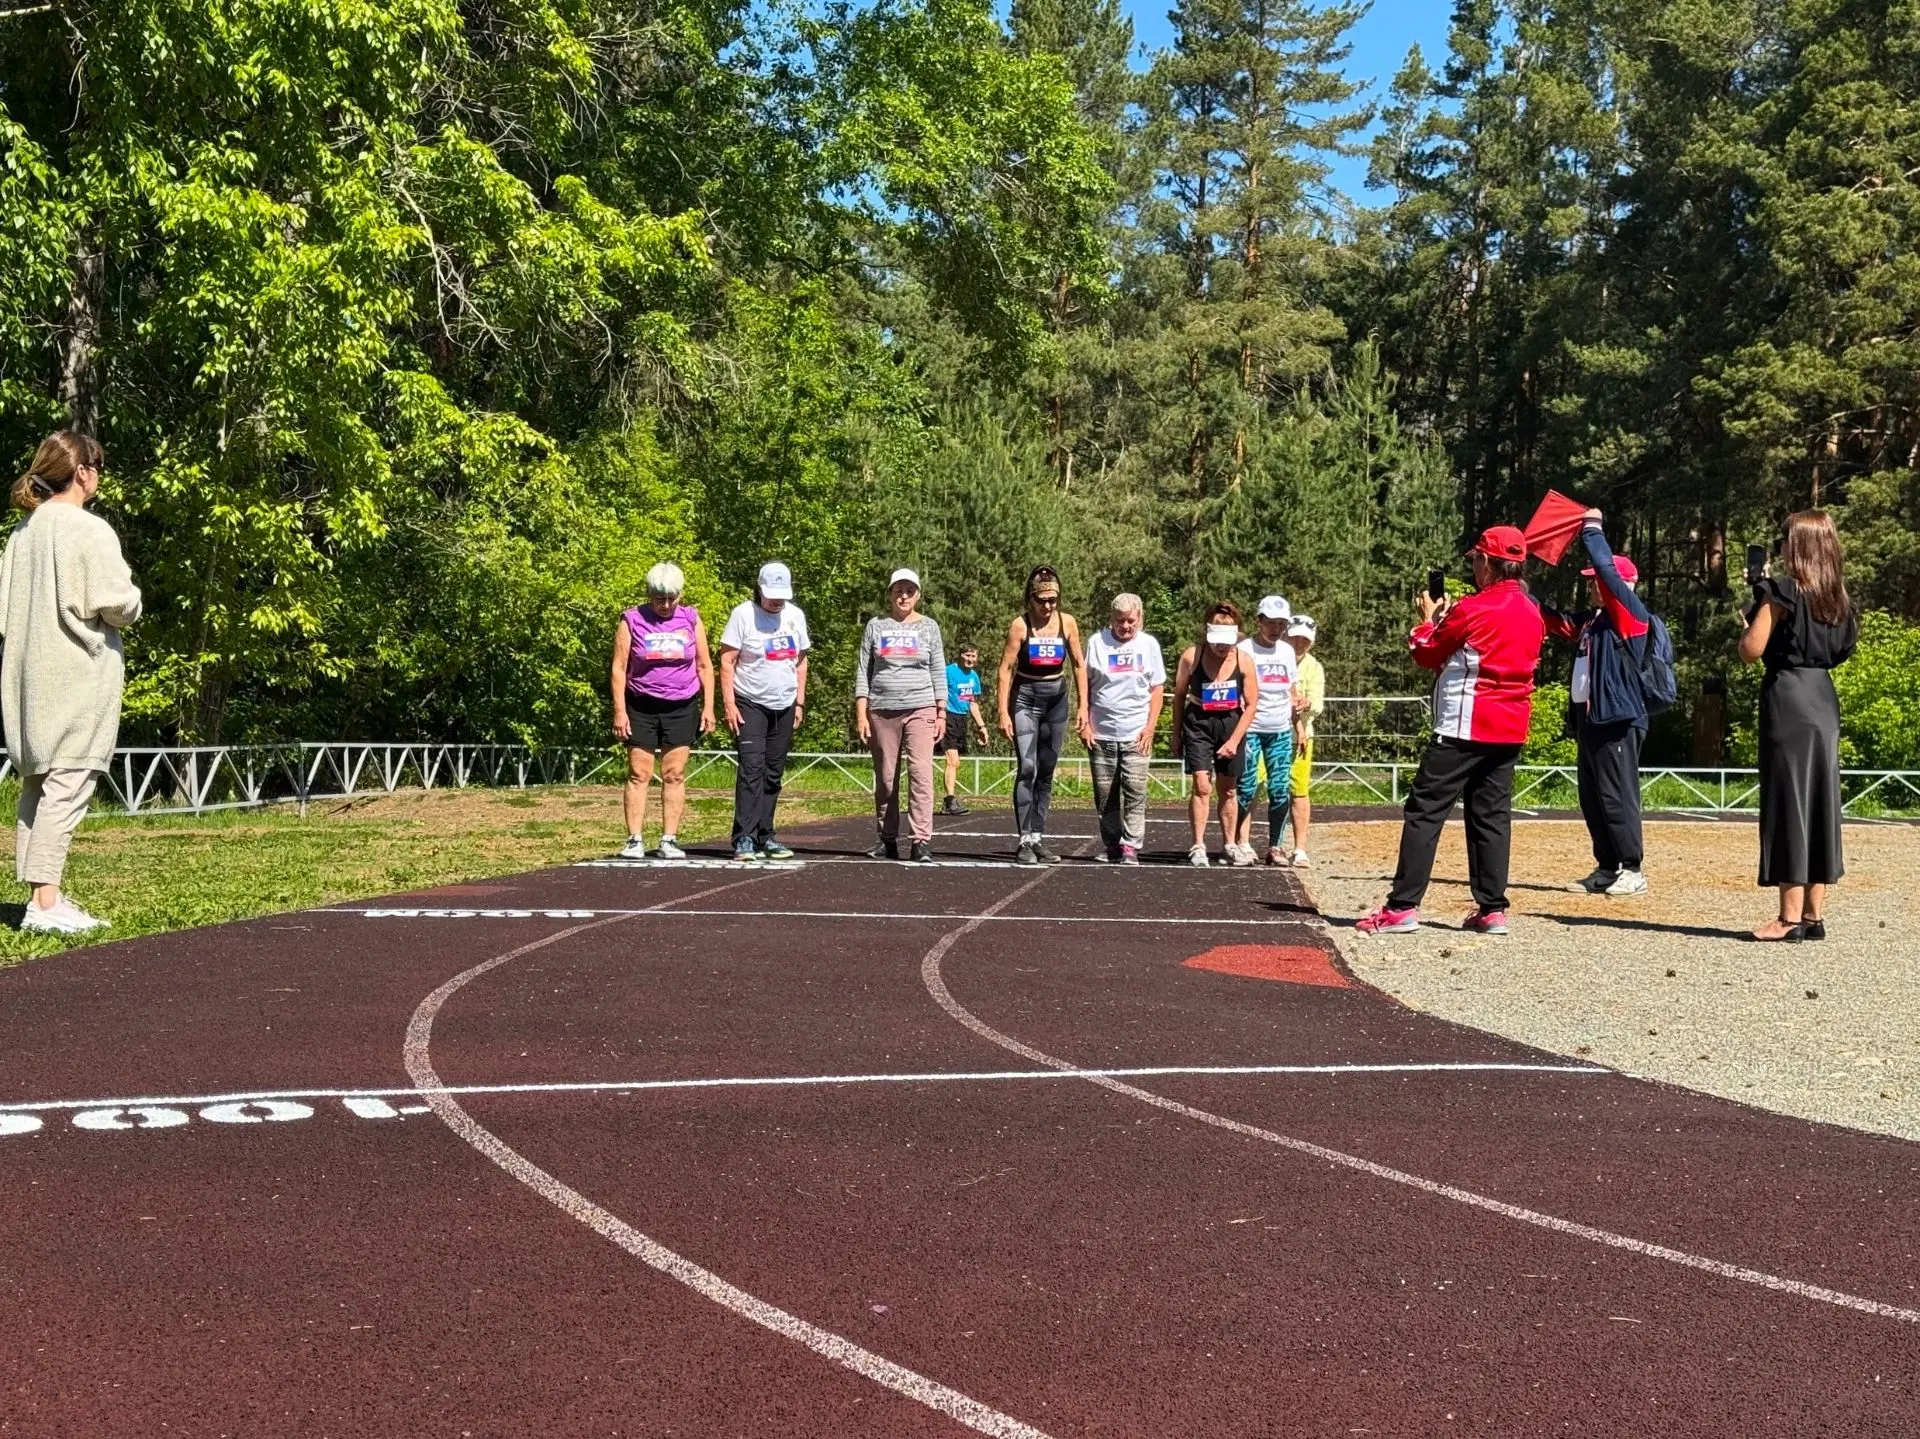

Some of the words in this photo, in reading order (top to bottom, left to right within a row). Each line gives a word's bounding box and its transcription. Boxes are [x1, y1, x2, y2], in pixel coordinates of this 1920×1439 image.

[772, 637, 789, 651] 53
[886, 637, 913, 648] 245
[1038, 645, 1056, 658] 55
[1117, 654, 1133, 666] 57
[1211, 689, 1229, 701] 47
